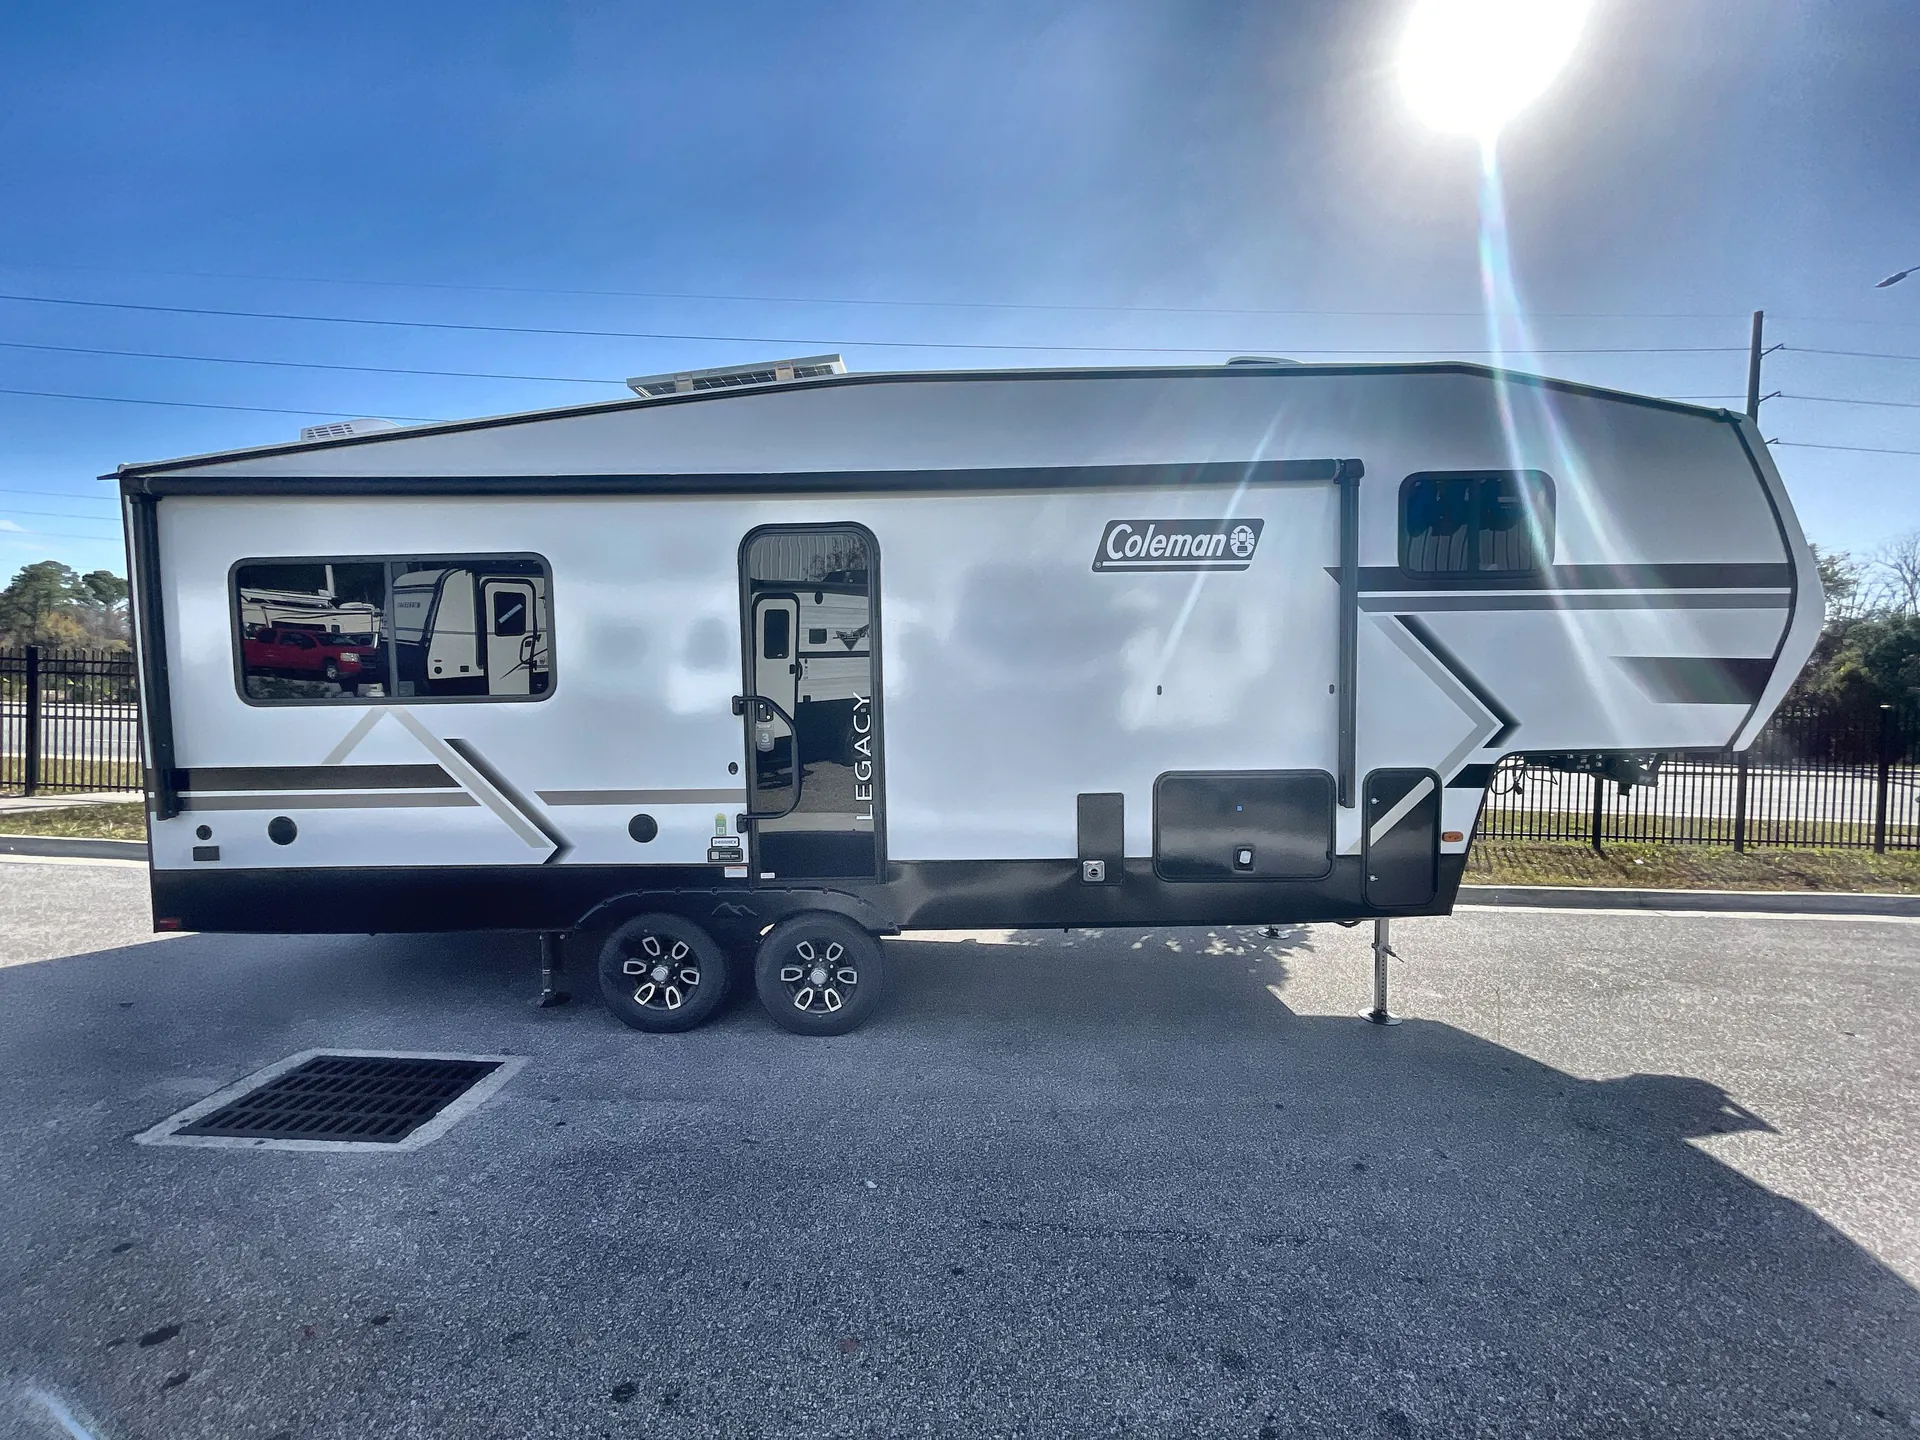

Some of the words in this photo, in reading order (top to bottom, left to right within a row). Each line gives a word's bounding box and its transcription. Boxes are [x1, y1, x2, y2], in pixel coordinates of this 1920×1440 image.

[1106, 523, 1227, 560] Coleman
[761, 733, 770, 743] 3
[852, 691, 874, 821] LEGACY
